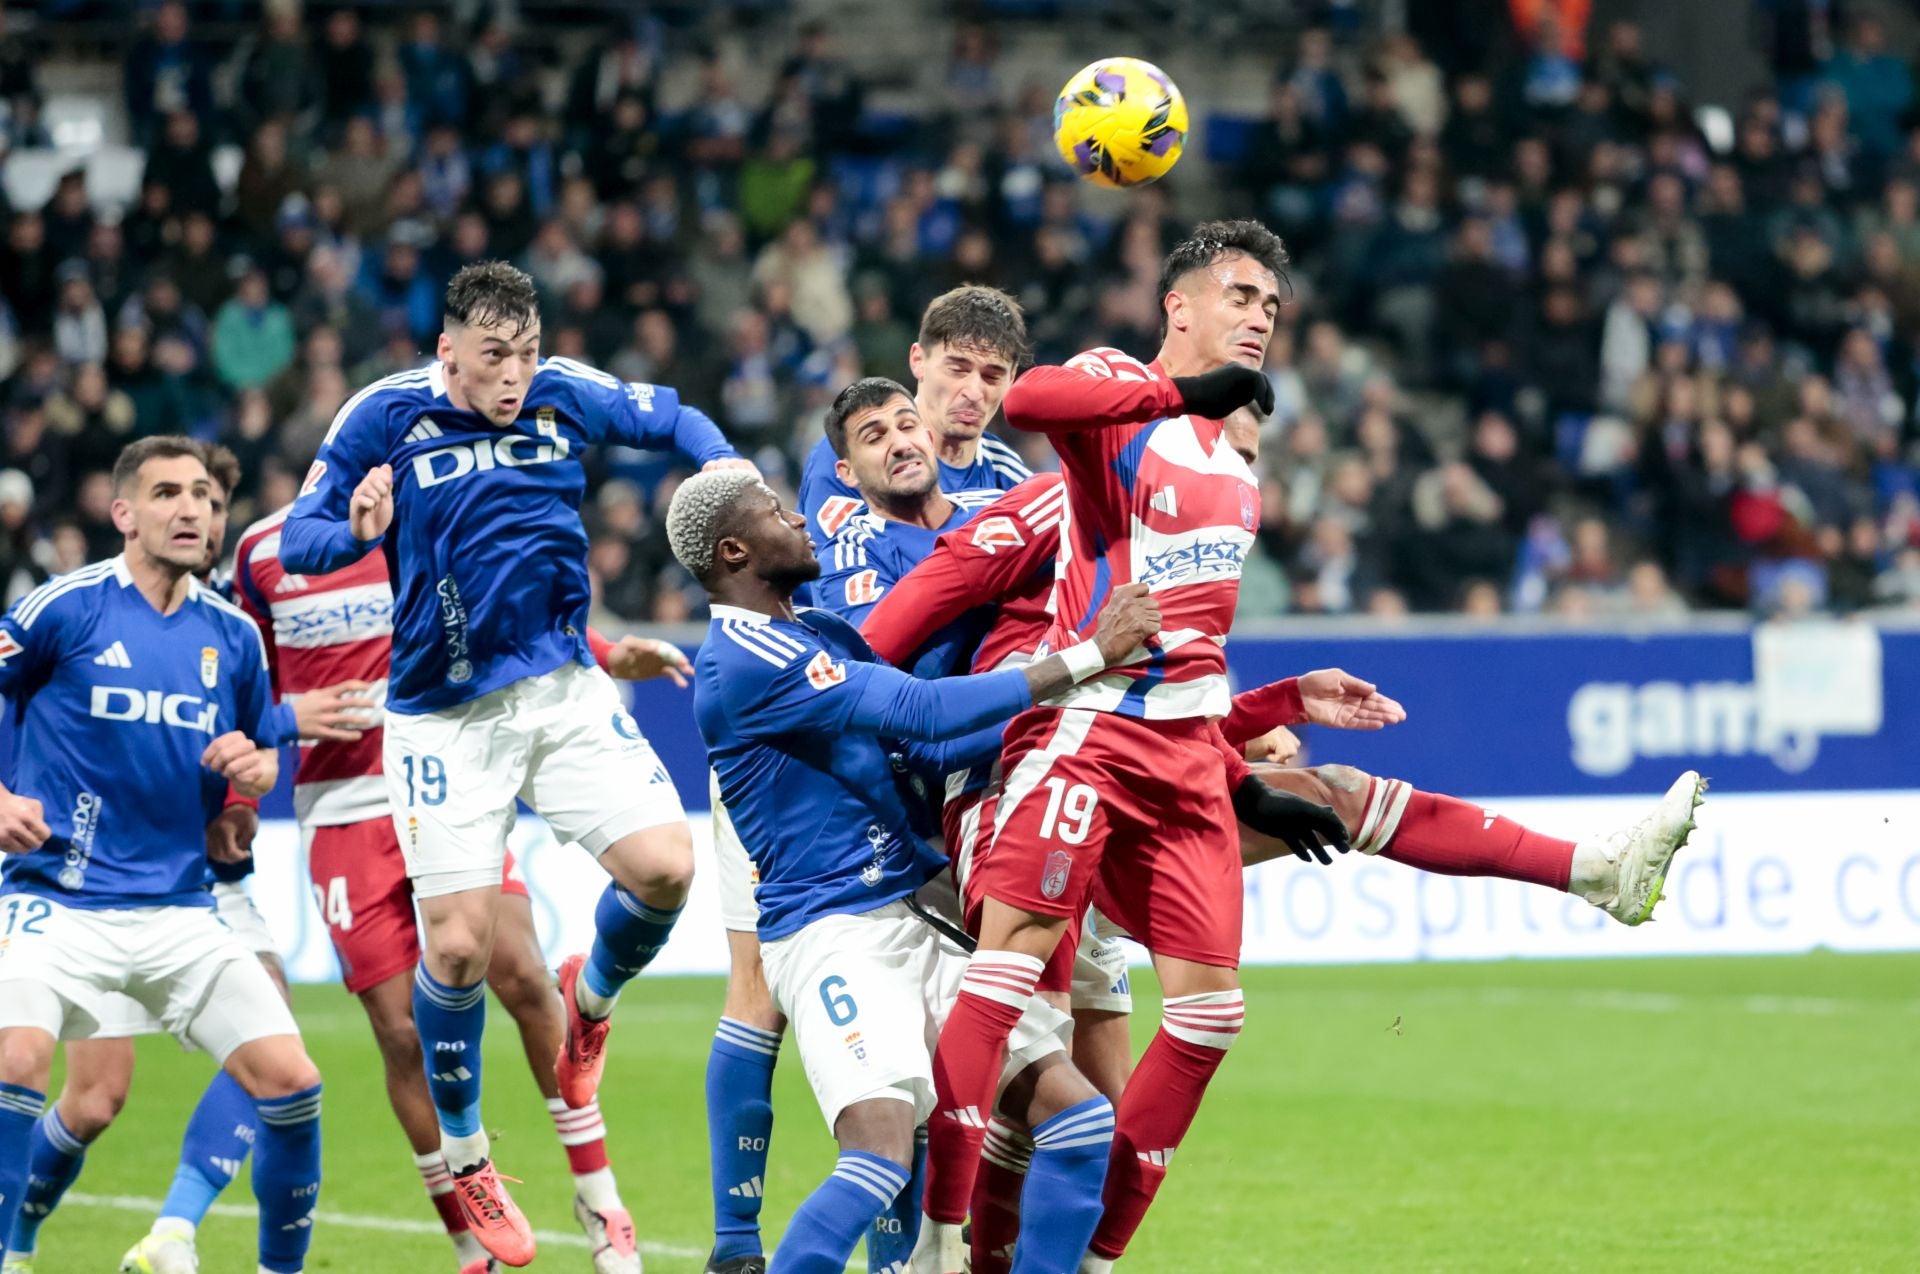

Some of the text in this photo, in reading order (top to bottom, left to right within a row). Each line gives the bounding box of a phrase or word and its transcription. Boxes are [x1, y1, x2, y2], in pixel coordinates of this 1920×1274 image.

[90, 685, 219, 735] DIGI
[403, 754, 447, 807] 19
[1039, 776, 1098, 844] 19
[1678, 832, 1793, 932] de
[6, 900, 52, 935] 12
[819, 975, 858, 1026] 6
[738, 1136, 765, 1152] RO
[876, 1216, 902, 1234] RO
